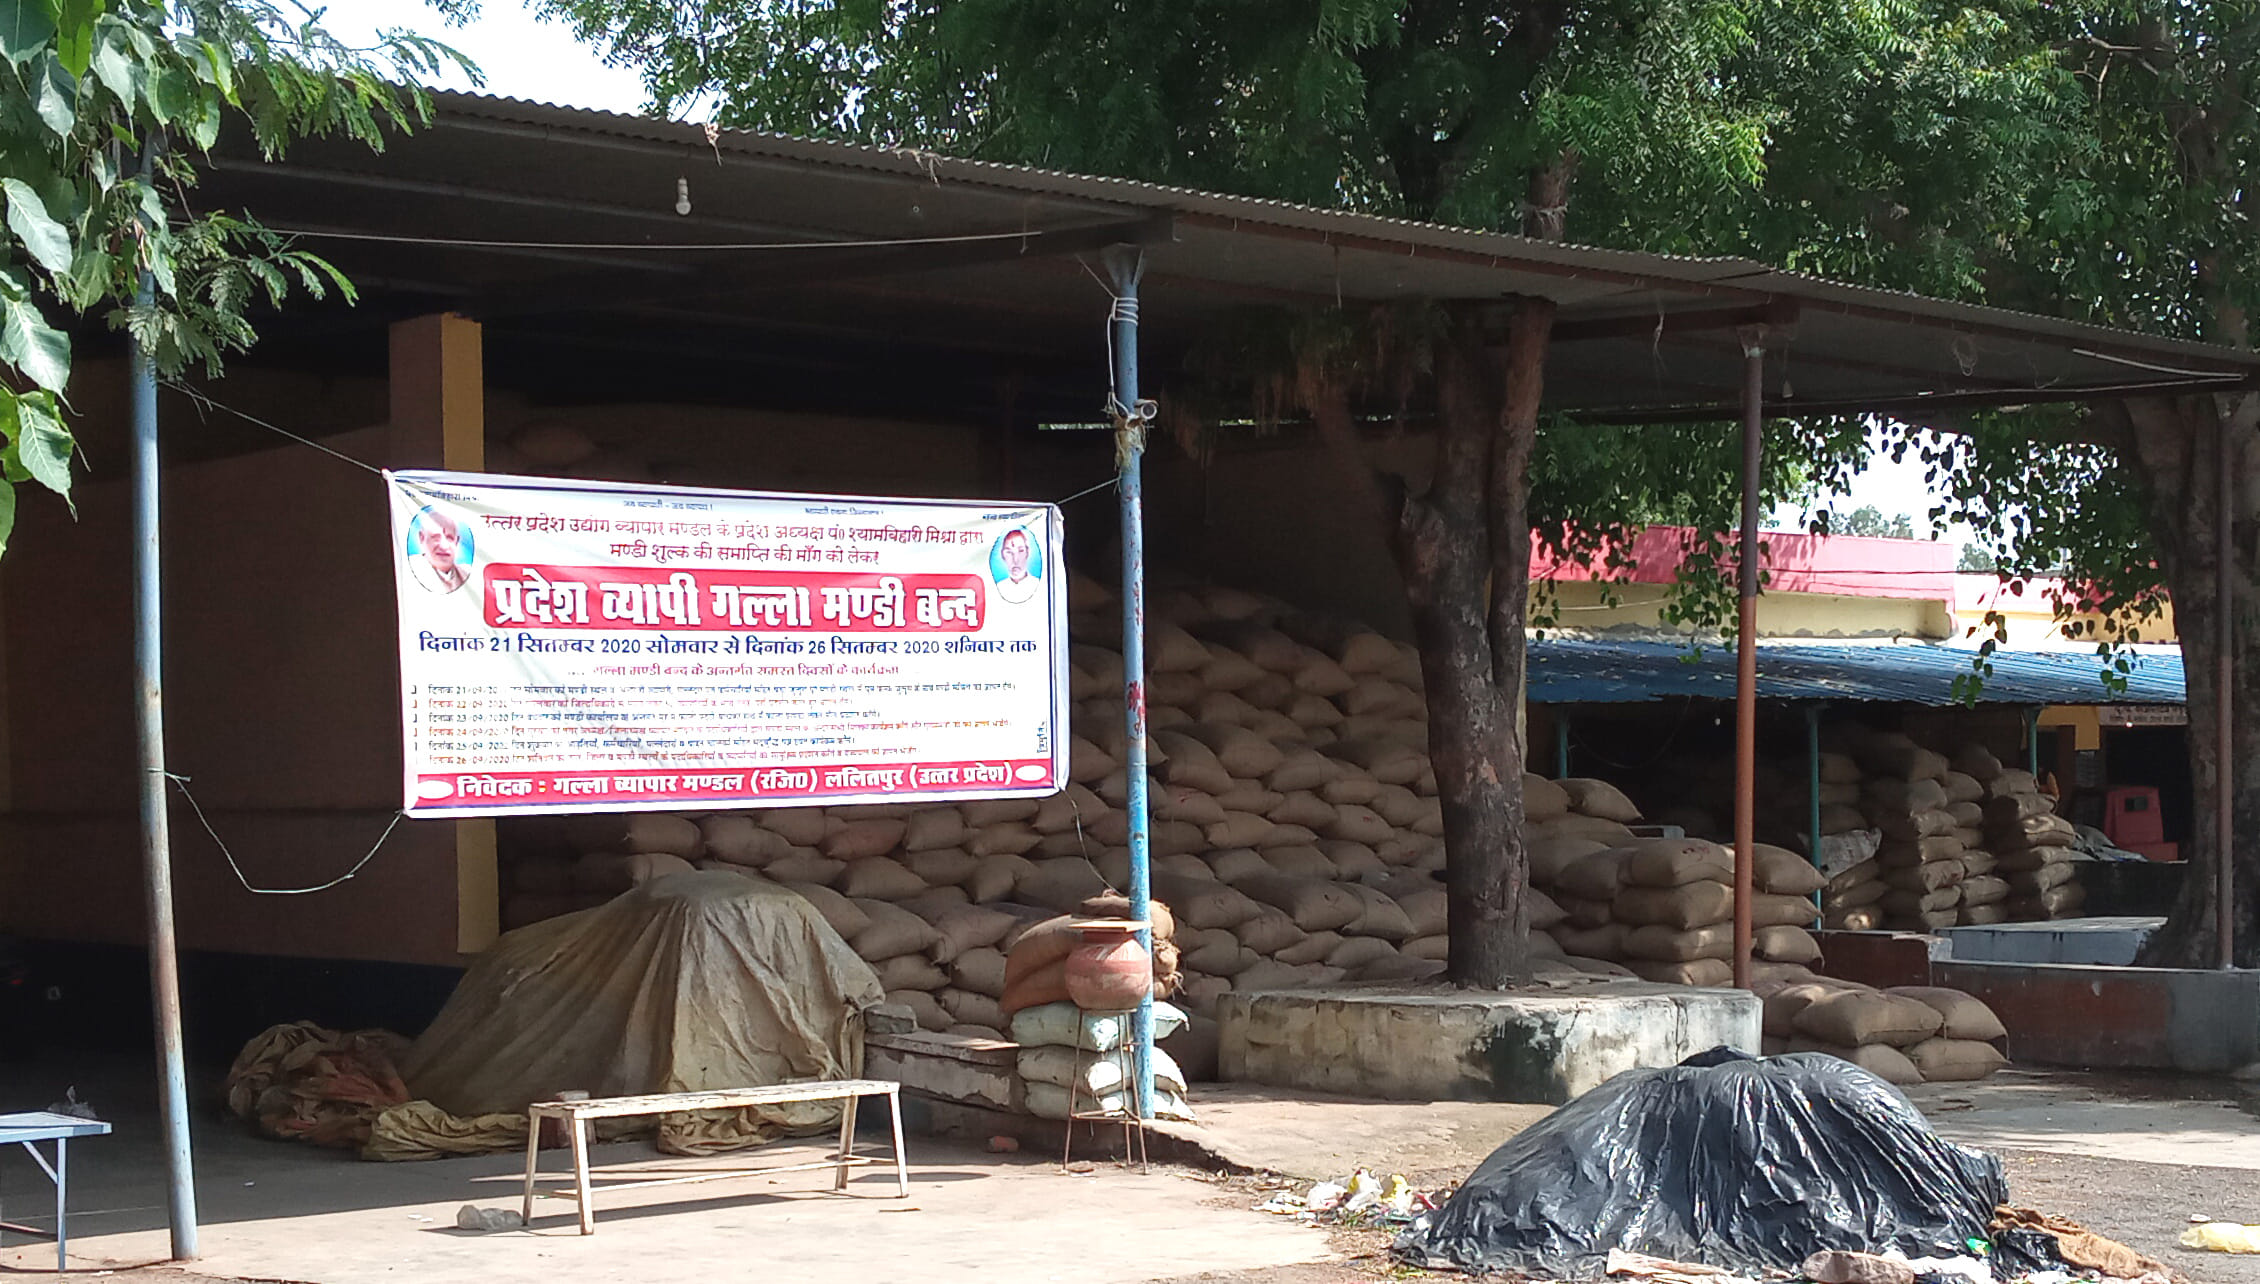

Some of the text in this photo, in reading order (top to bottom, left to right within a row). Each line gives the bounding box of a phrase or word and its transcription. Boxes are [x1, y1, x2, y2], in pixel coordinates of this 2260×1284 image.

[527, 512, 565, 534] प्रदेश
[615, 520, 664, 535] व्यापार
[668, 522, 711, 536] मण्डल
[734, 520, 769, 540] प्रदेश
[775, 526, 824, 541] अध्यक्ष
[926, 526, 956, 543] मिश्रा
[960, 531, 983, 545] द्वारा
[610, 539, 648, 558] मण्डी
[652, 544, 689, 563] शुल्क
[694, 541, 713, 559] की
[717, 543, 770, 562] समाप्ति
[774, 544, 792, 561] की
[826, 545, 843, 562] को
[848, 546, 879, 565] लेकर
[492, 568, 979, 627] प्रदेश व्यापी गल्ला मण्डी बन्द
[419, 630, 484, 652] दिनांक
[490, 637, 511, 652] 21
[601, 639, 640, 653] 2020
[646, 634, 718, 654] सोमवार
[723, 634, 741, 654] से
[746, 635, 803, 655] दिनांक
[808, 641, 825, 655] 26
[904, 640, 939, 654] 2020
[944, 635, 1005, 654] शनिवार
[1010, 639, 1036, 653] तक
[457, 774, 533, 797] निवेदक
[553, 776, 610, 794] गल्ला
[613, 775, 680, 792] व्यापार
[682, 773, 745, 791] मण्डल
[824, 766, 904, 791] ललितपुर
[910, 764, 959, 789] (उत्तर
[963, 761, 1013, 786] प्रदेश)
